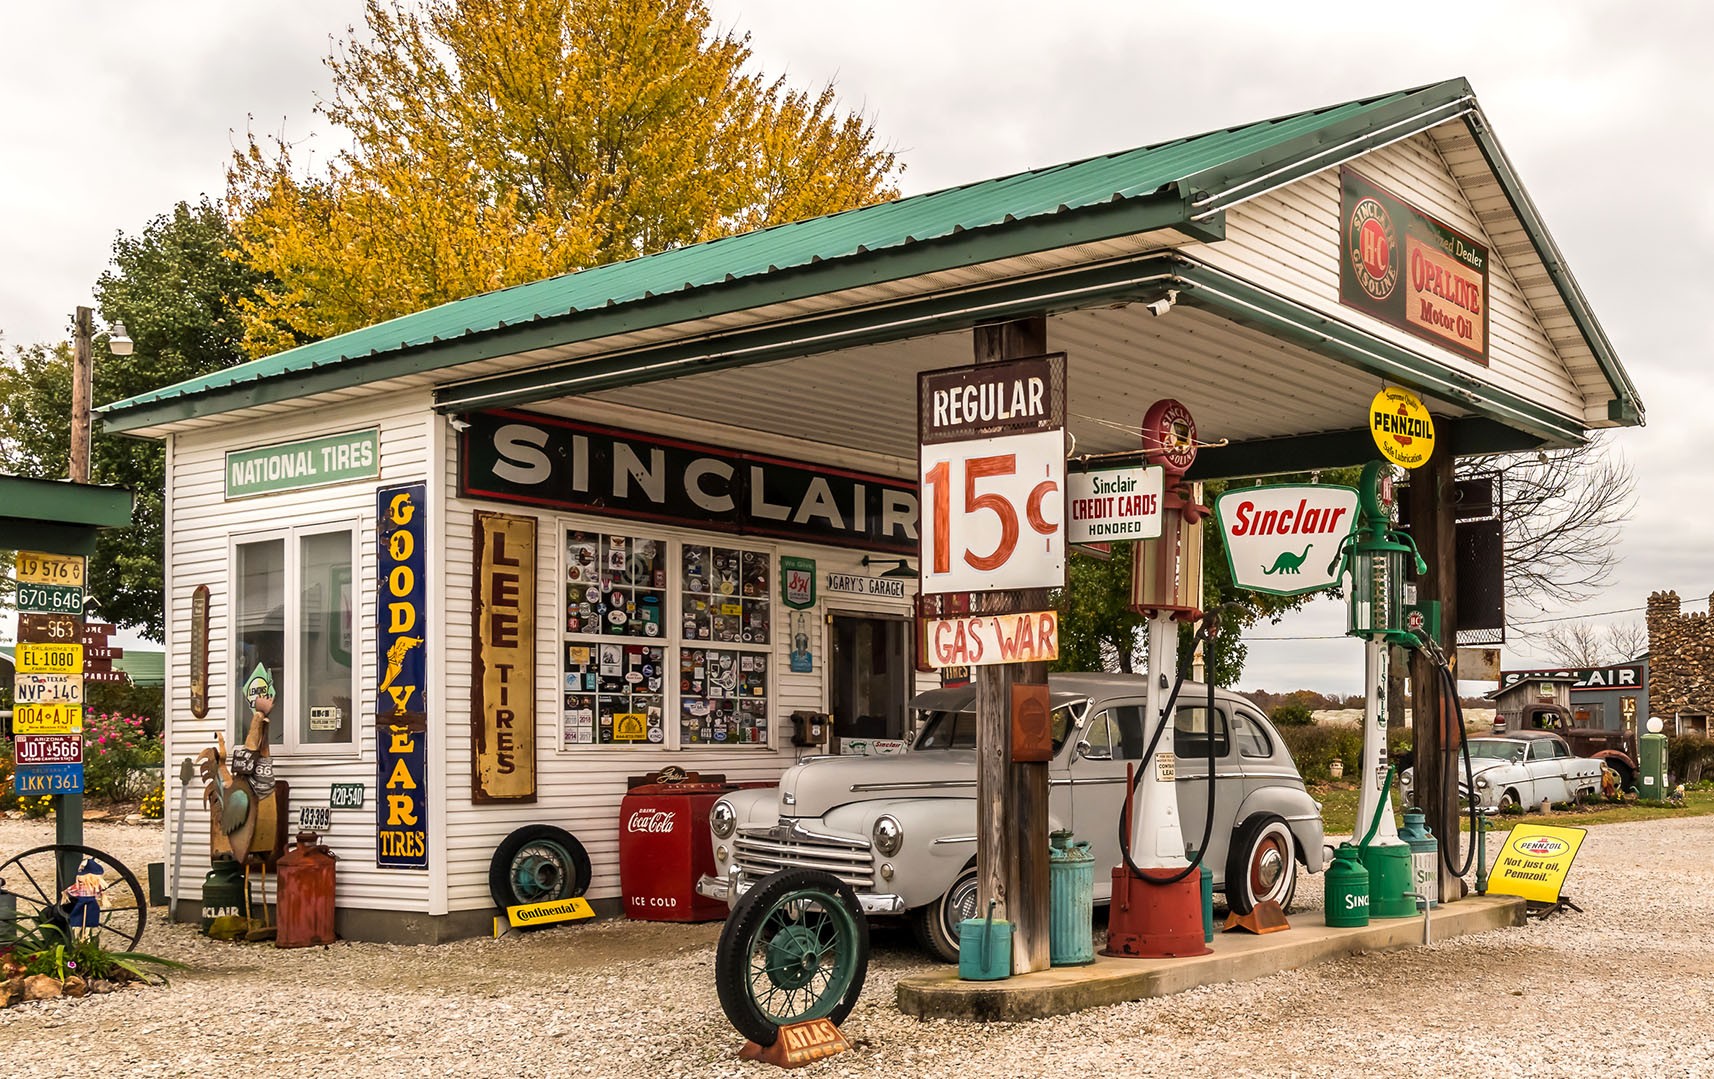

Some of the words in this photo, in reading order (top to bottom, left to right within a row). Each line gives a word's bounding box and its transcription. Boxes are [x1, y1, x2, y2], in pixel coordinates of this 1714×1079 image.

[1456, 241, 1482, 268] Dealer
[1353, 248, 1396, 296] GASOLINE
[1412, 247, 1480, 315] OPALINE
[1420, 298, 1455, 331] Motor
[1456, 314, 1473, 340] Oil
[933, 377, 1044, 427] REGULAR
[1374, 412, 1433, 439] PENNZOIL
[1383, 441, 1395, 457] Safe
[1395, 449, 1423, 463] Lubrication
[232, 451, 316, 487] NATIONAL
[321, 440, 373, 472] TIRES
[491, 423, 918, 540] SINCLAIR
[1093, 475, 1137, 494] Sinclair
[1072, 497, 1114, 520] CREDIT
[1118, 494, 1157, 517] CARDS
[1231, 499, 1346, 536] Sinclair
[1089, 521, 1141, 535] HONORED
[20, 559, 37, 576] 19
[42, 561, 67, 578] 576
[491, 531, 520, 648] LEE
[833, 576, 864, 592] GARY'S
[869, 580, 900, 596] GARAGE
[19, 589, 80, 608] 670-646
[935, 618, 984, 664] GAS
[993, 613, 1055, 660] WAR
[248, 686, 267, 696] LEMONS
[18, 708, 43, 724] 004
[53, 709, 78, 725] AJF
[494, 664, 515, 775] TIRES
[20, 742, 46, 758] JDT
[52, 742, 79, 757] 566
[20, 774, 79, 790] 1KKY361
[255, 766, 272, 776] 66
[332, 788, 363, 805] 420-540
[627, 811, 677, 833] Coca-Cola
[380, 830, 425, 858] TIRES
[1504, 857, 1522, 865] Not
[1523, 859, 1544, 869] just
[1545, 863, 1560, 872] oil,
[516, 903, 577, 921] Continental
[631, 896, 646, 906] ICE
[650, 897, 677, 907] COLD
[786, 1022, 836, 1050] ATLAS
[791, 1043, 845, 1062] TIRES
